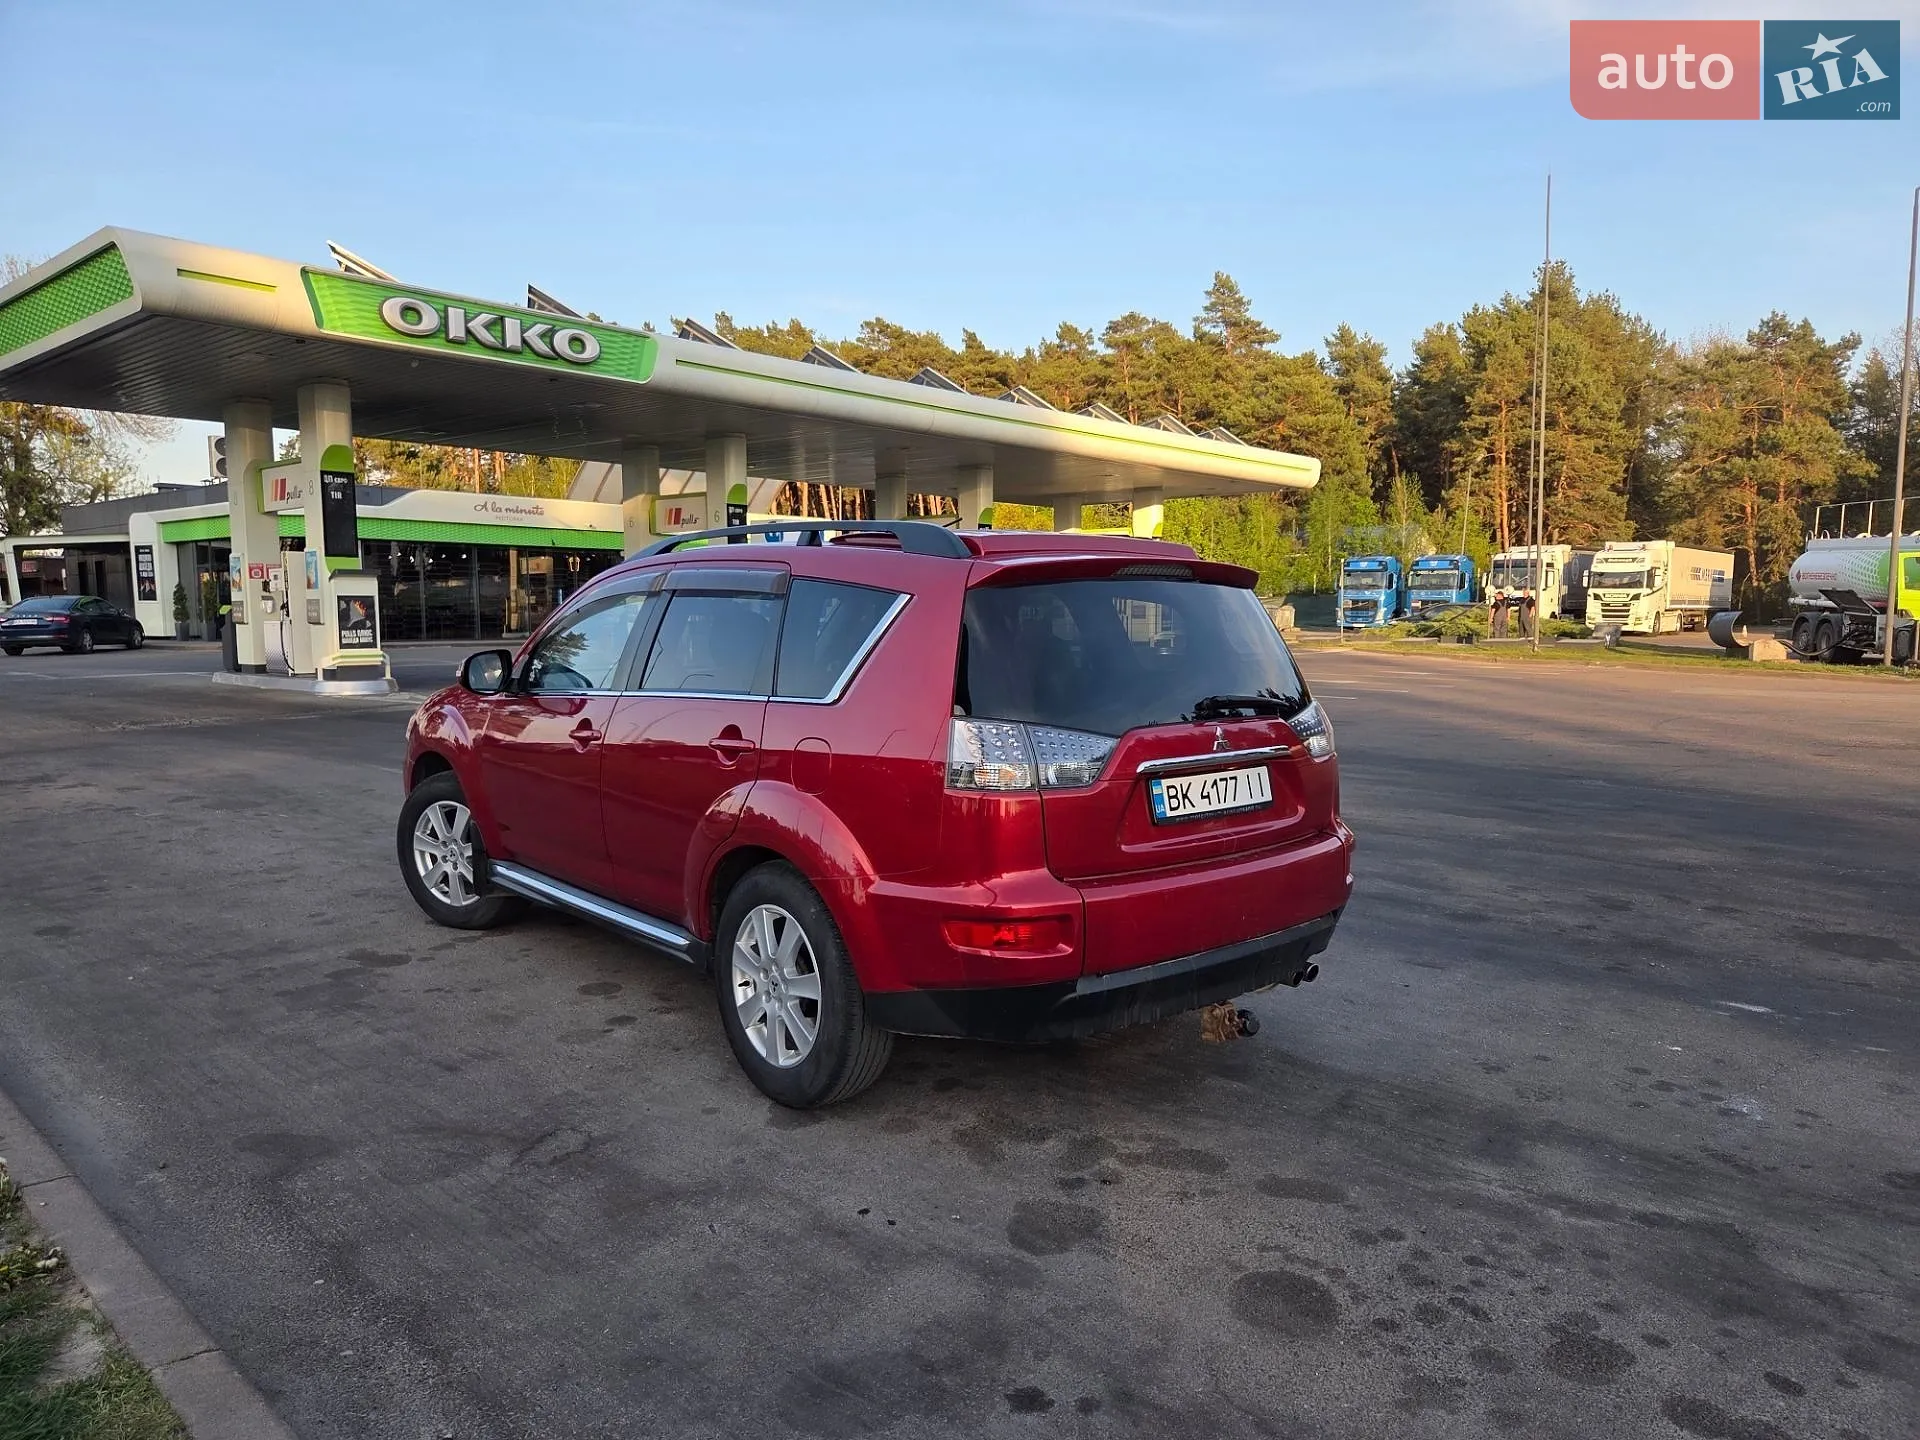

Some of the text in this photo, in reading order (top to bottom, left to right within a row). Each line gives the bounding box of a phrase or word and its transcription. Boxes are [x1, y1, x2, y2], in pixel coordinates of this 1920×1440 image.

[379, 297, 601, 363] OKKO
[286, 485, 303, 504] pulls
[308, 480, 314, 495] 8
[491, 502, 502, 513] la
[681, 513, 700, 528] pulls
[713, 510, 720, 523] 6
[1166, 782, 1196, 812] BK
[1201, 777, 1237, 806] 4177
[1155, 804, 1165, 813] UA
